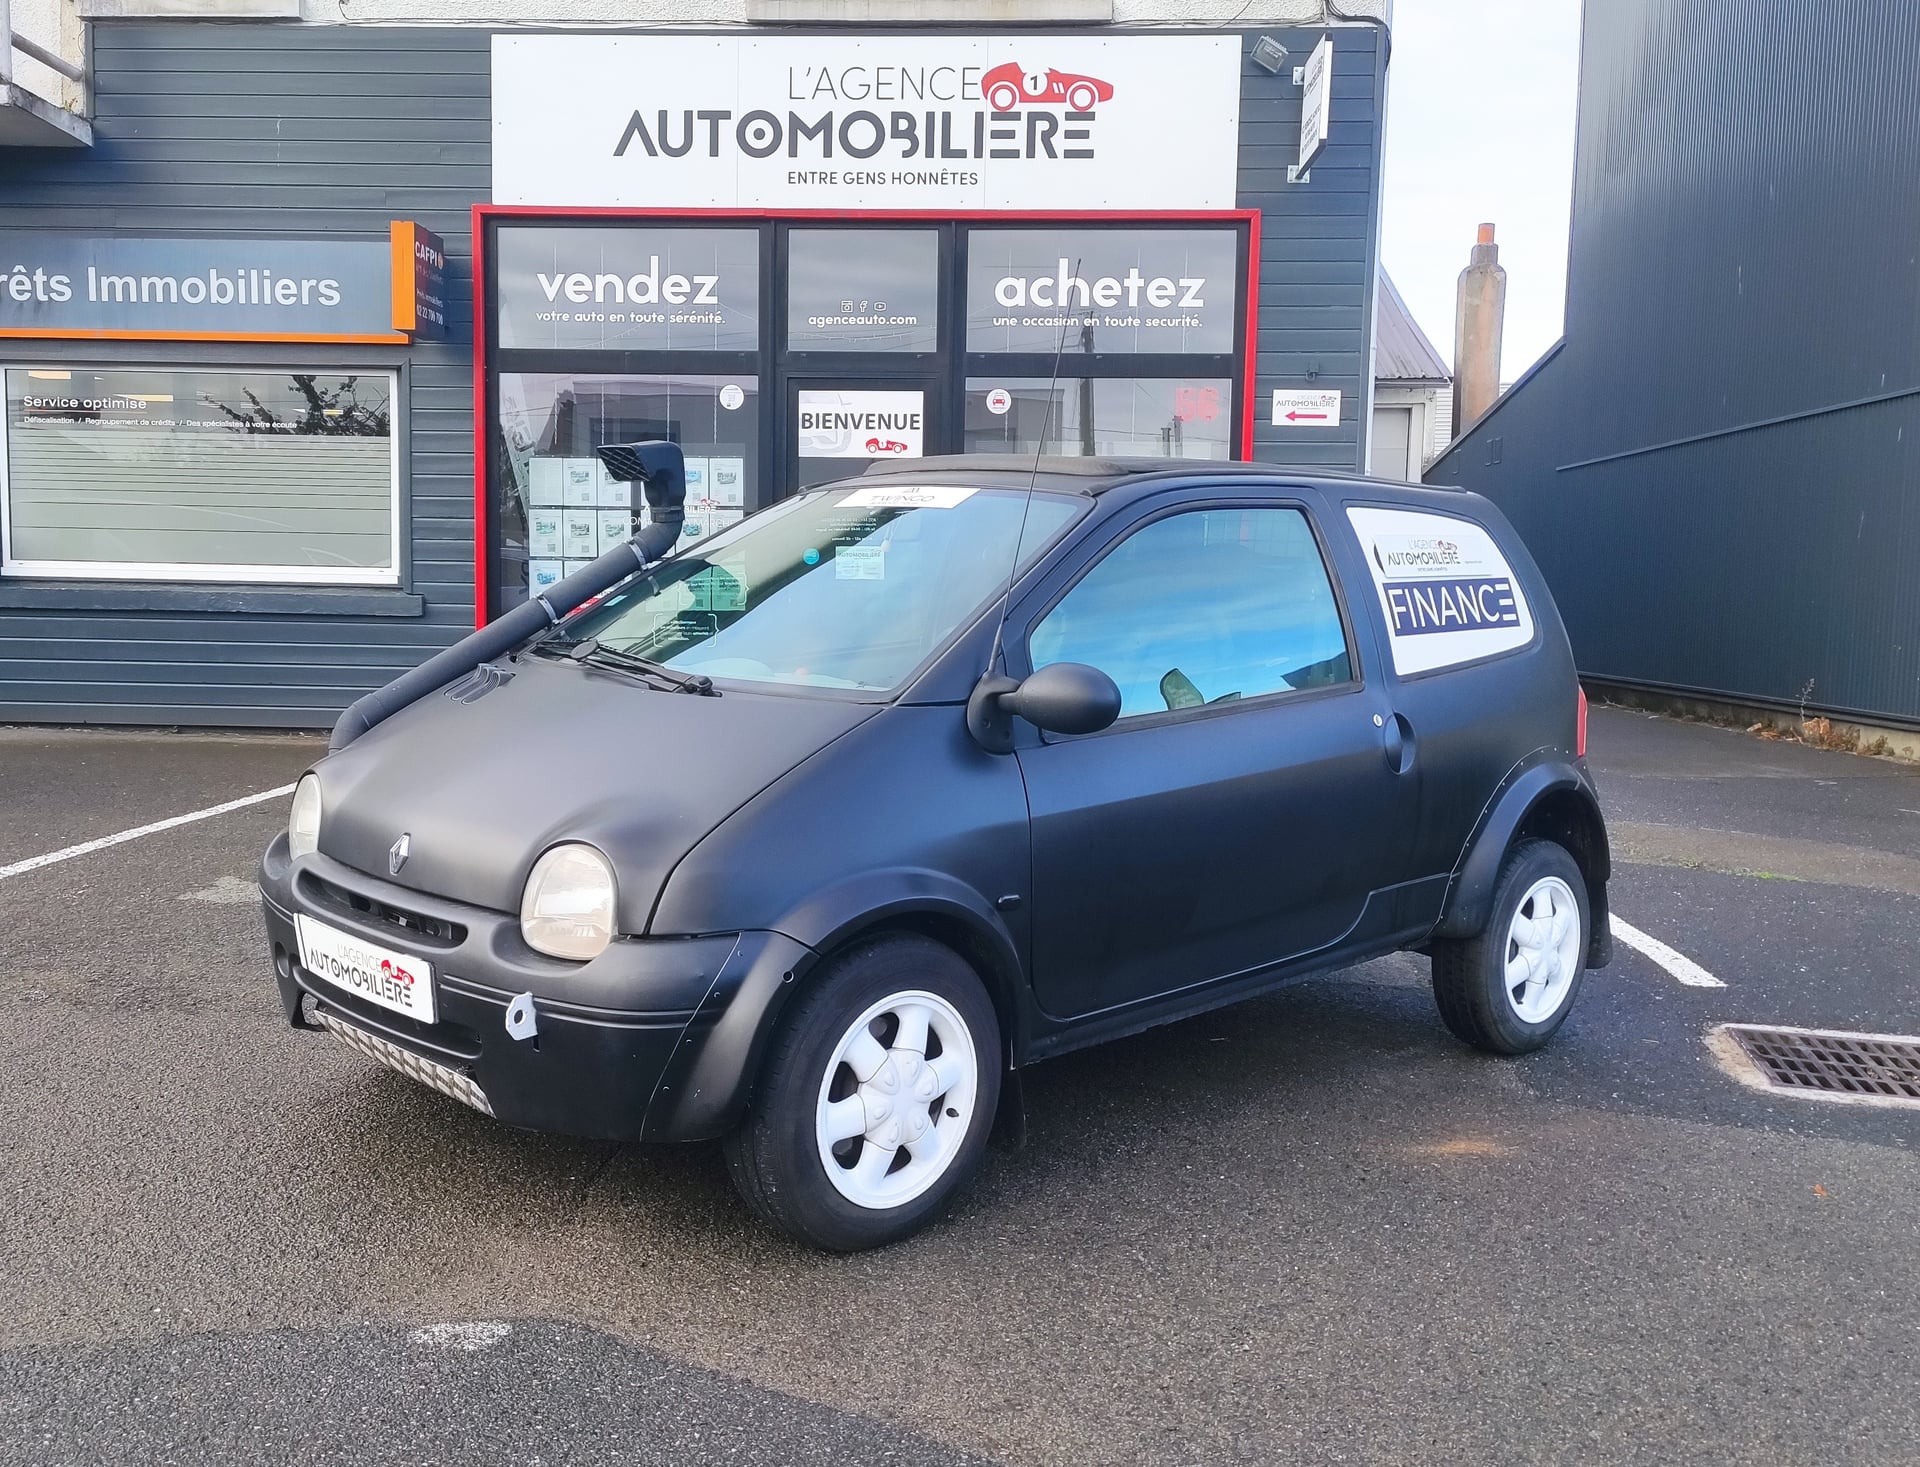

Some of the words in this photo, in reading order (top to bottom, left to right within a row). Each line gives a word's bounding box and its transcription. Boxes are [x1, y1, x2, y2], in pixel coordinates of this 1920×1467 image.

[788, 66, 981, 100] L'AGENCE
[612, 109, 1096, 159] AUTOMOBILIERE
[787, 171, 838, 185] ENTRE
[842, 171, 886, 185] GENS
[891, 168, 979, 185] HONNÊTES
[415, 241, 438, 267] CAFPI
[0, 265, 73, 302] êts
[87, 266, 342, 306] Immobiliers
[536, 255, 720, 305] vendez
[994, 257, 1206, 308] achetez
[536, 311, 570, 322] votre
[574, 311, 605, 323] auto
[609, 313, 625, 323] en
[629, 311, 665, 323] toute
[669, 309, 726, 324] sérénité.
[808, 314, 918, 328] agenceauto.com
[993, 317, 1018, 327] une
[1022, 313, 1079, 327] occasion
[1083, 317, 1100, 327] en
[1104, 314, 1141, 328] toute
[1145, 313, 1203, 327] securité.
[23, 395, 79, 408] Service
[83, 397, 147, 411] optimise
[24, 416, 75, 424] Défiscalisation
[85, 417, 139, 427] Regroupement
[139, 418, 149, 426] de
[151, 418, 176, 427] crédits
[186, 419, 201, 427] Des
[202, 419, 244, 429] spécialistes
[271, 420, 298, 429] écoute
[801, 412, 920, 430] BIENVENUE
[1387, 551, 1461, 566] AUTOMOBILIERE
[1387, 583, 1518, 630] FINANCE
[337, 943, 382, 973] L'AGENCE
[310, 947, 413, 1008] AUTOMOBILIERE
